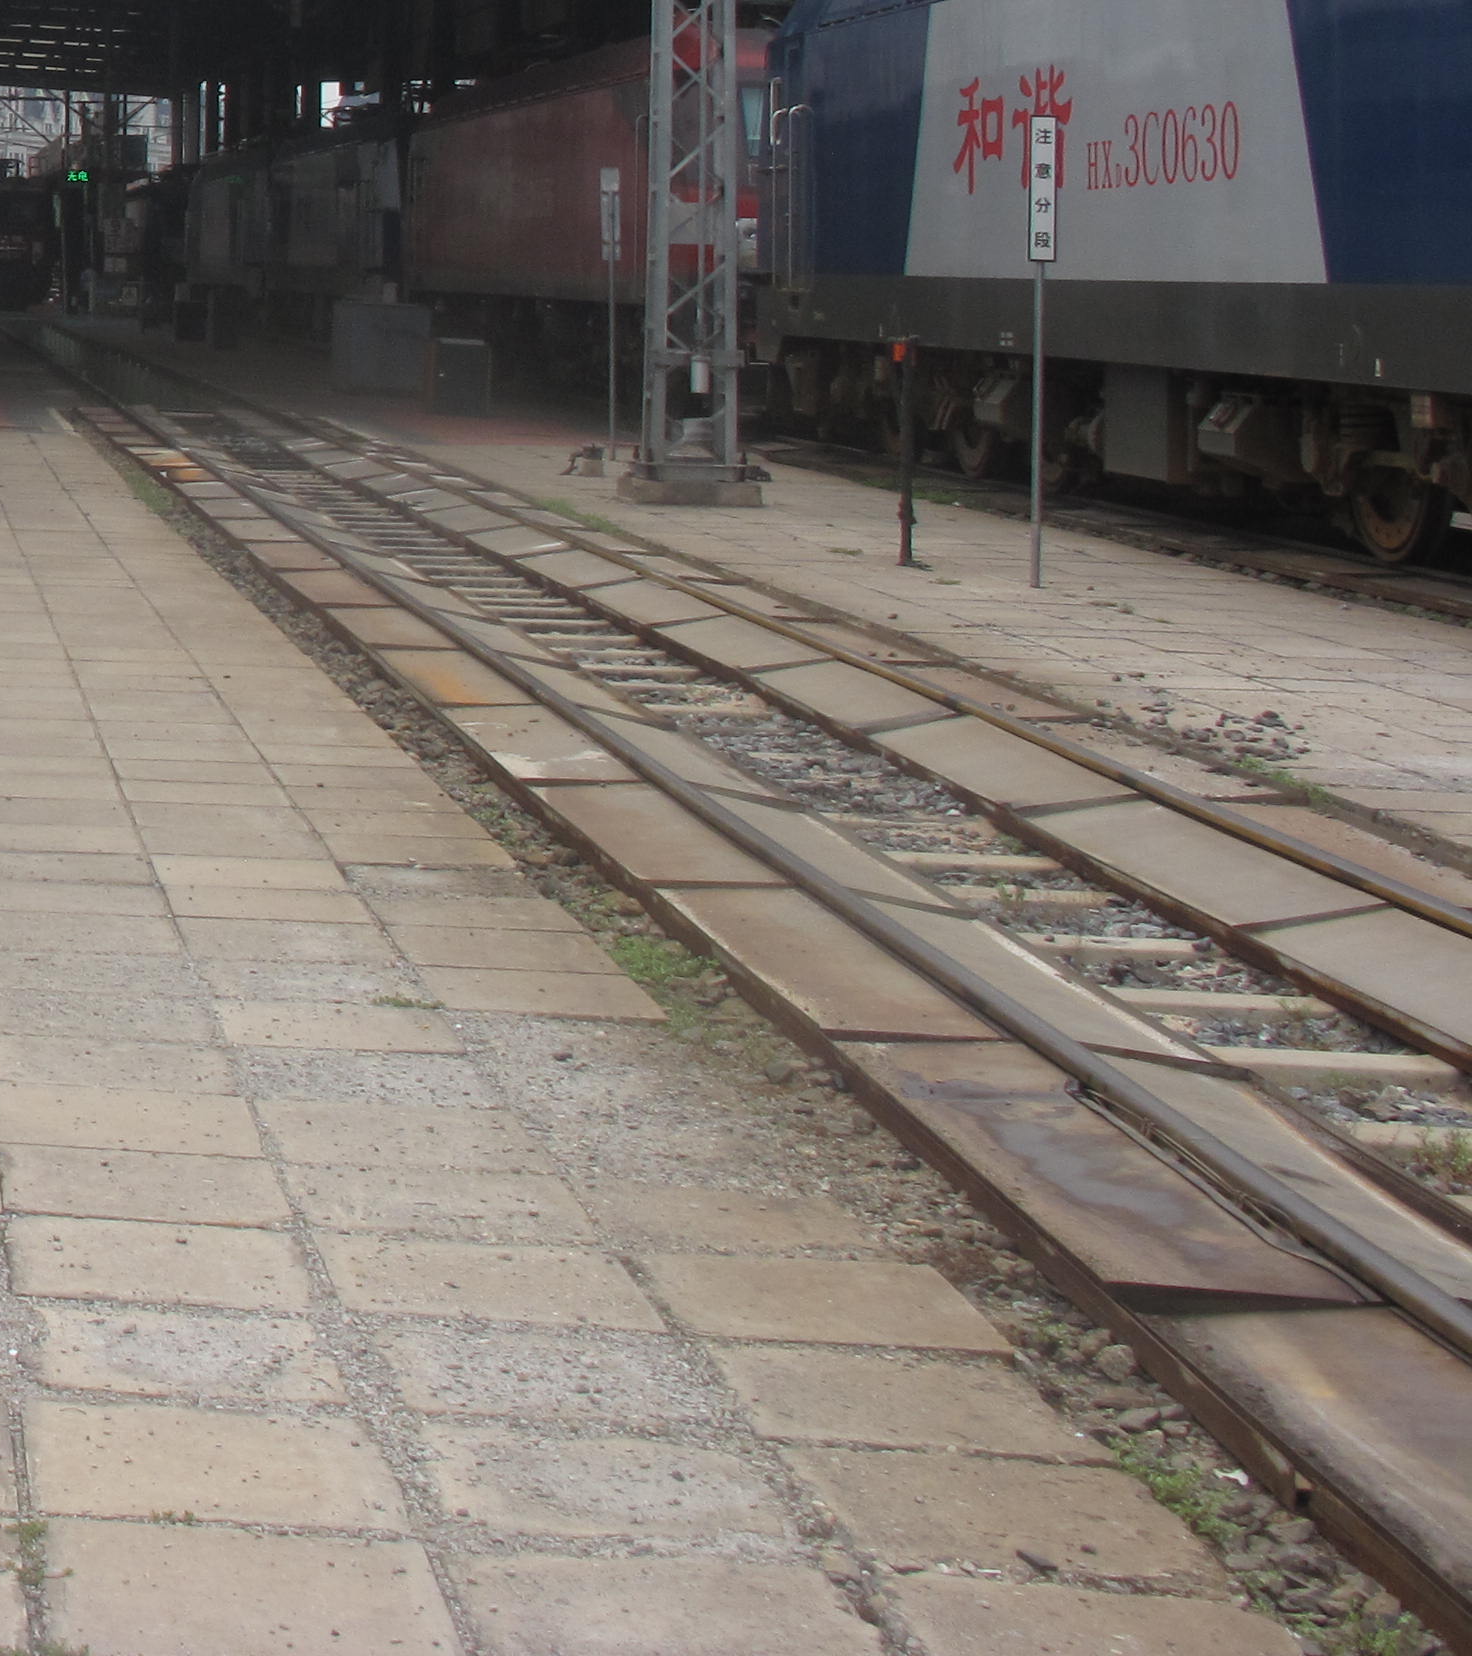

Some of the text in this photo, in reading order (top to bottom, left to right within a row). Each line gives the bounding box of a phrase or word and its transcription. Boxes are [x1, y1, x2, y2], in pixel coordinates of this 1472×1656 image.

[952, 64, 1073, 195] 和谐
[1034, 128, 1053, 248] 注意分段
